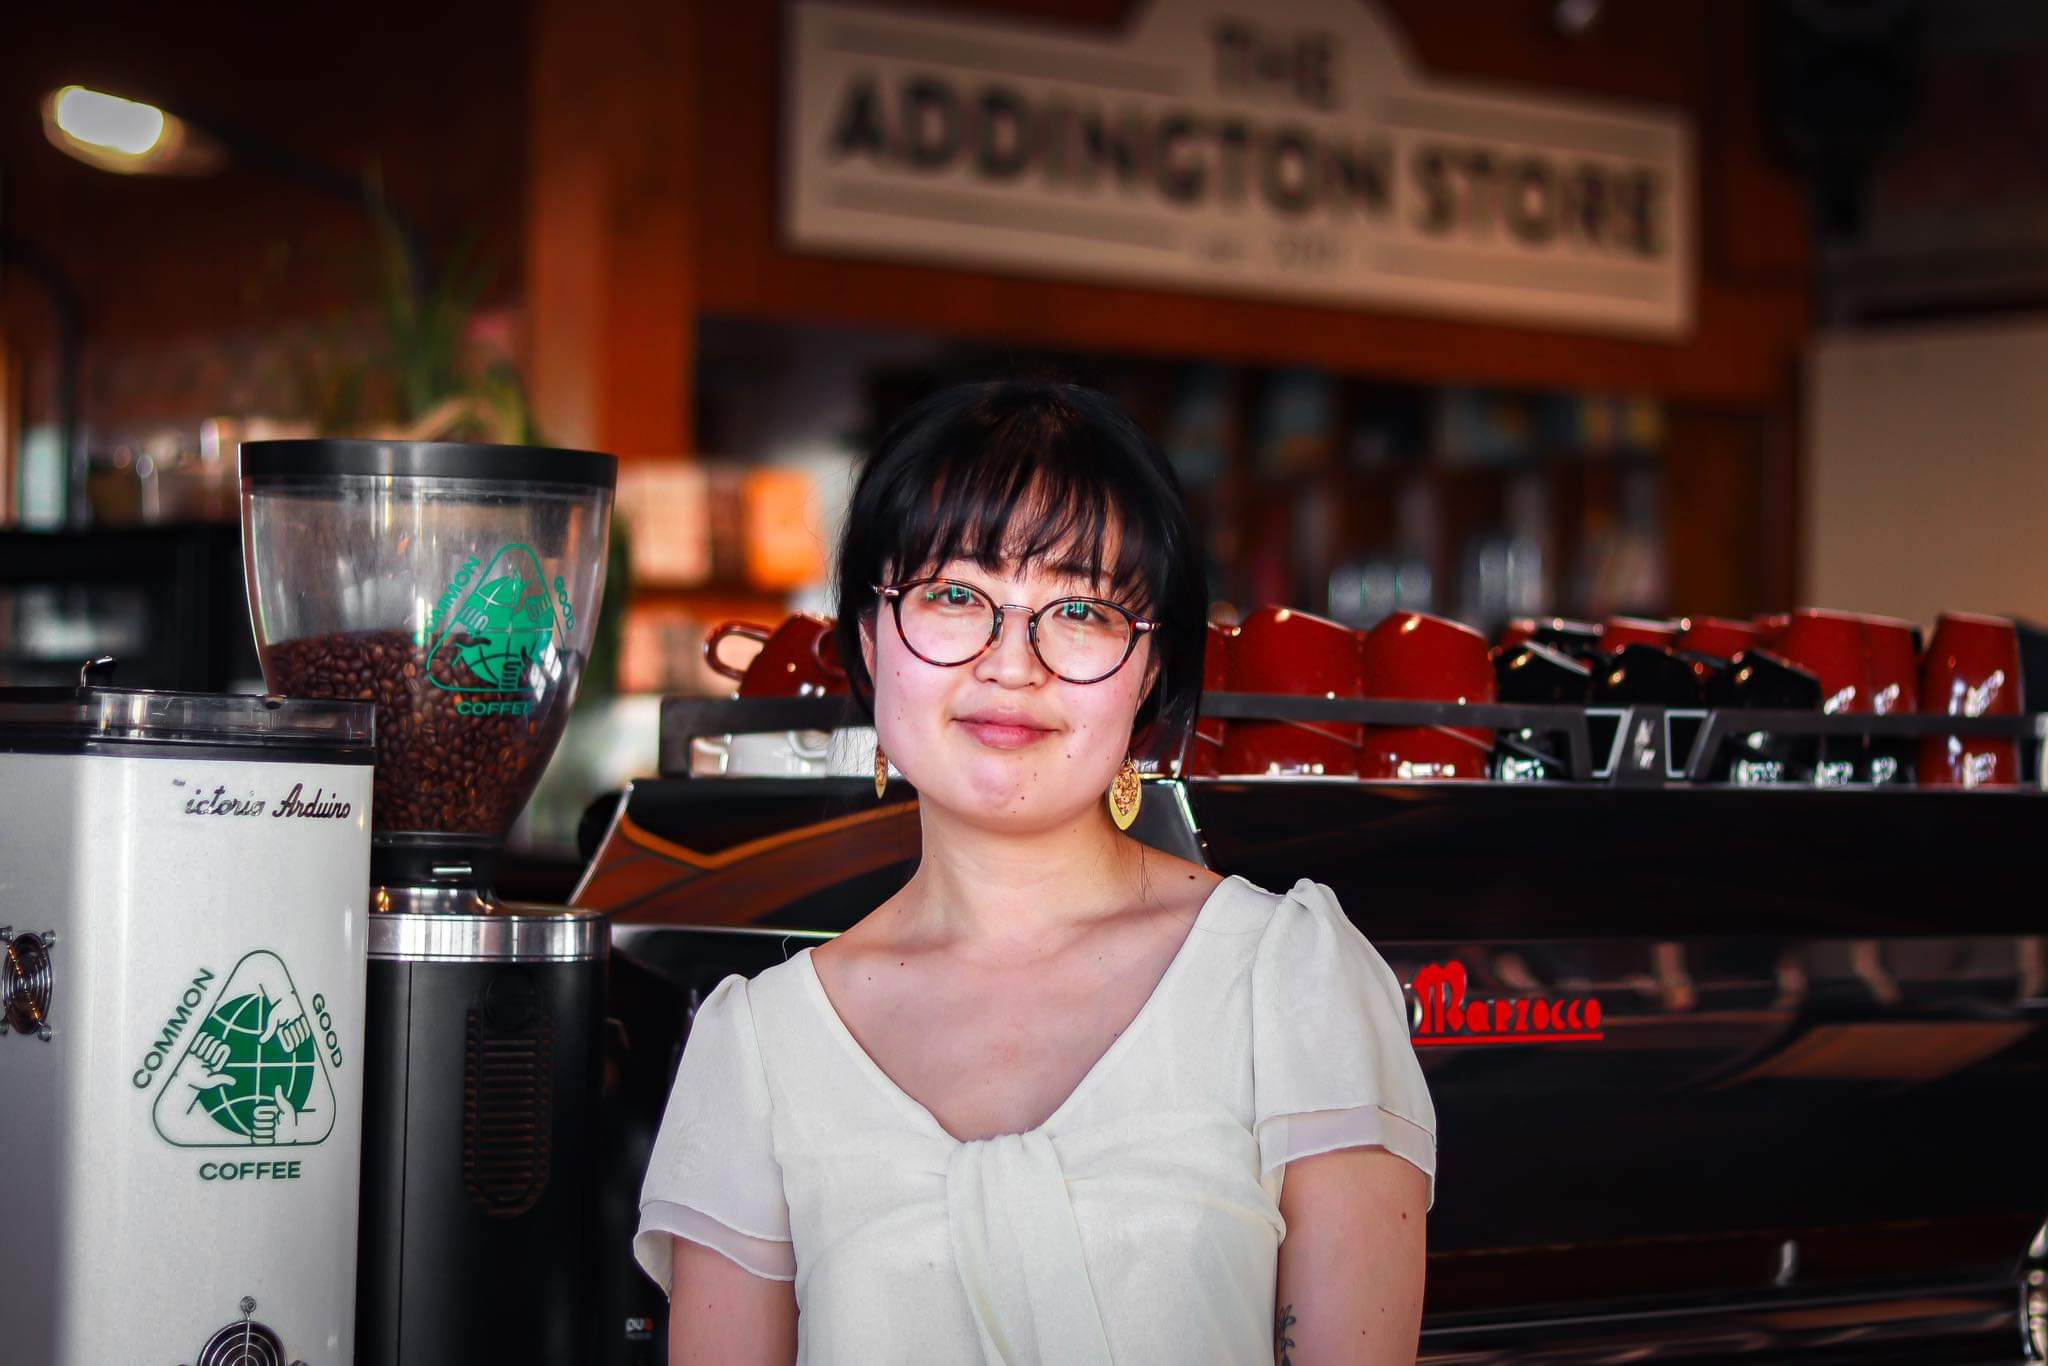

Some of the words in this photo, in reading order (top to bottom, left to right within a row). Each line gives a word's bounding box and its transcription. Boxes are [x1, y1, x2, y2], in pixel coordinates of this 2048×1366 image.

[1212, 24, 1341, 110] THE
[830, 72, 1392, 224] ADDINGTON
[1414, 145, 1665, 258] STORE
[173, 779, 265, 817] ictoria
[272, 783, 351, 818] Arduino
[132, 967, 215, 1089] COMMON
[312, 993, 343, 1068] GOOD
[199, 1161, 301, 1181] COFFEE
